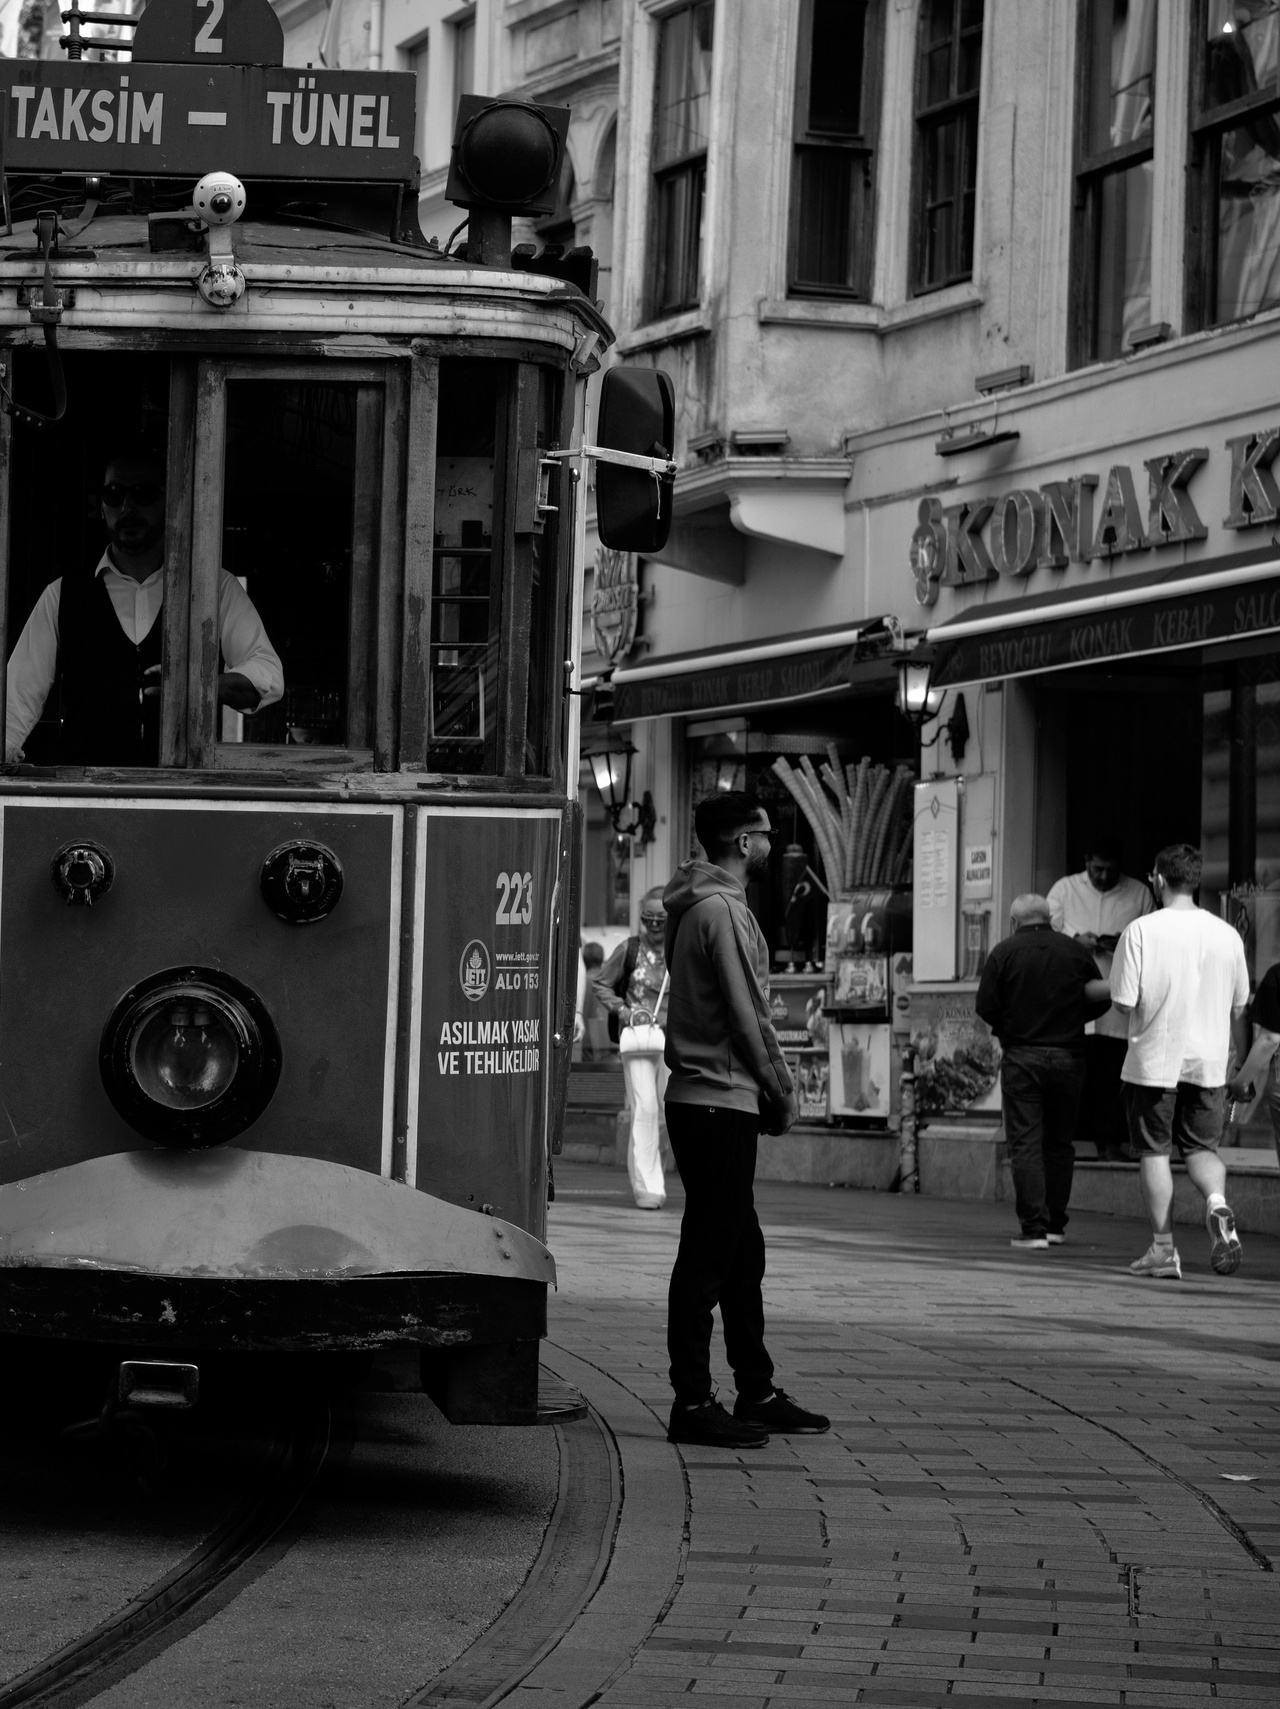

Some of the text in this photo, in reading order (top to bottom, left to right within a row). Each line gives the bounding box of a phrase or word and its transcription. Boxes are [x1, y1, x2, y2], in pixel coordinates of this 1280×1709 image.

[194, 0, 223, 53] 2
[11, 75, 164, 145] TAKSİM
[266, 77, 400, 148] TÜNEL
[941, 448, 1209, 587] KONAK
[978, 630, 1051, 677] BEYOĞLU
[1069, 617, 1133, 661] KONAK
[1152, 602, 1214, 647] KEBAP
[737, 669, 773, 701] KEBAP
[495, 871, 533, 925] 223
[495, 951, 540, 963] www.iett.gov.tr
[495, 972, 539, 990] ALO 153
[439, 1019, 540, 1045] ASILMAK YASAK
[437, 1045, 539, 1075] VE TEHLİKELİDİR
